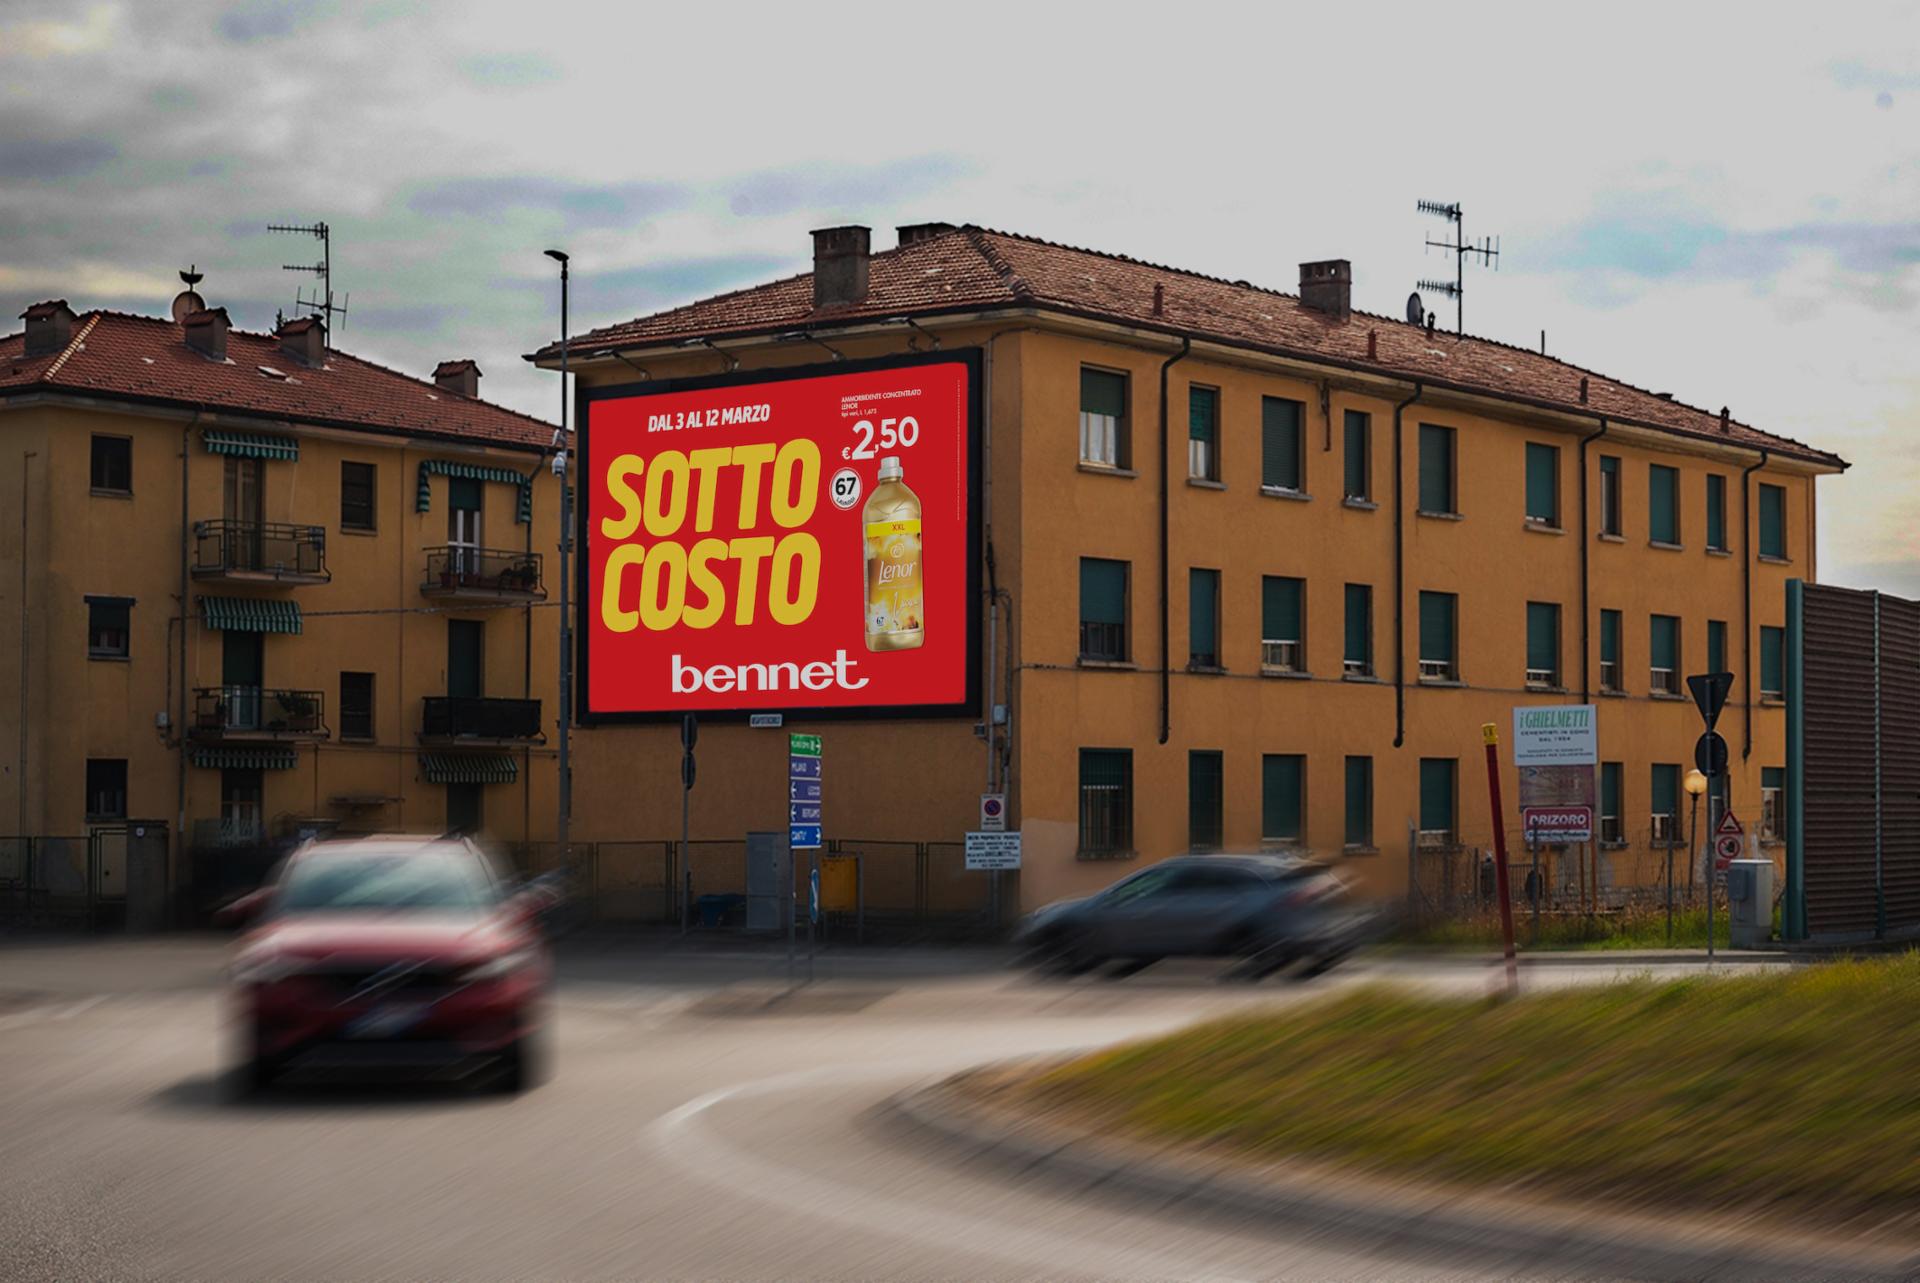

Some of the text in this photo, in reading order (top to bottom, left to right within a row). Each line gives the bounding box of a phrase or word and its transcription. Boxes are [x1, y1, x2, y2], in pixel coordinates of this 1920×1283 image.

[841, 389, 922, 403] AMMORBIDENTE CONCENTRATO
[841, 402, 858, 410] LENOR
[648, 404, 770, 432] DAL 3 AL 12 MARZO
[601, 438, 821, 540] SOTTO
[835, 477, 857, 496] 67
[892, 523, 905, 531] XXL
[601, 532, 821, 632] COSTO
[878, 560, 917, 585] Lenor
[671, 649, 870, 693] bennet
[1525, 709, 1589, 729] GHIELMETTI
[1529, 814, 1587, 825] DRIZORO
